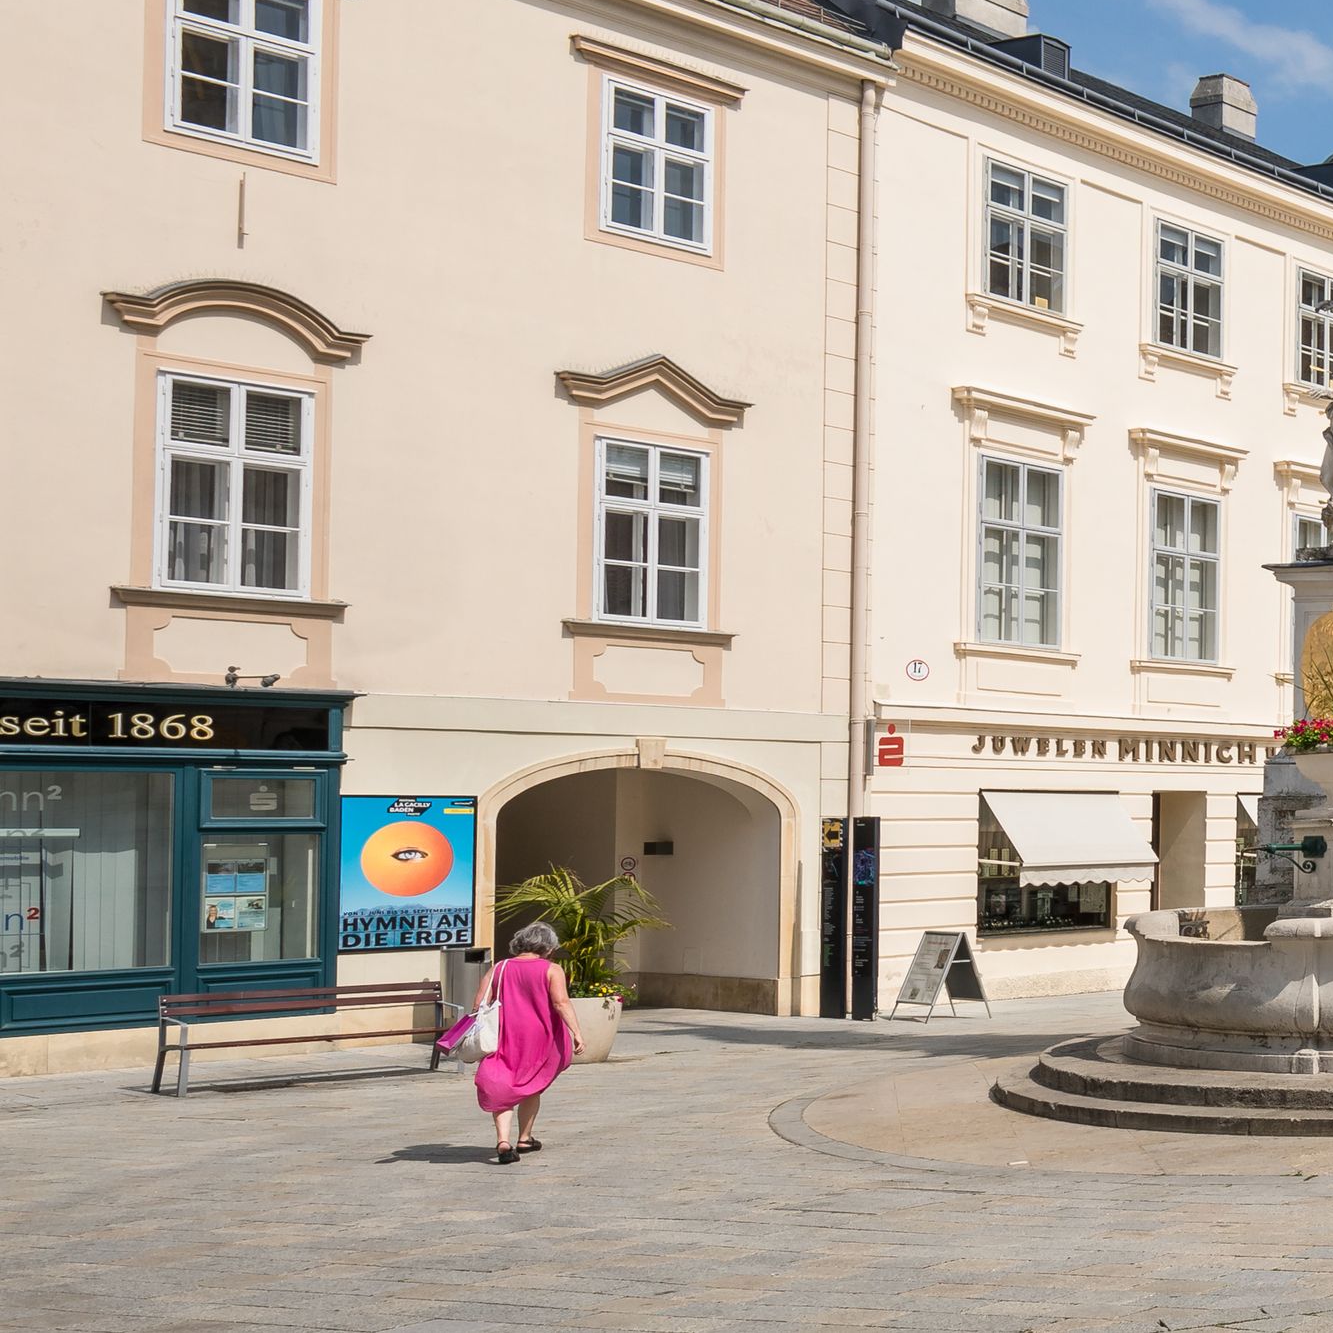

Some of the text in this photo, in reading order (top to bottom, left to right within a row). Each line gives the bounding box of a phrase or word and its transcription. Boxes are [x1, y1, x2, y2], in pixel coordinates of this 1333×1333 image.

[913, 662, 923, 673] 17
[0, 710, 214, 740] seit 1868
[971, 734, 1107, 759] JUWELEN
[1118, 738, 1257, 764] MINNICH
[342, 914, 469, 932] HYMNE AN
[342, 929, 469, 947] DIE ERDE
